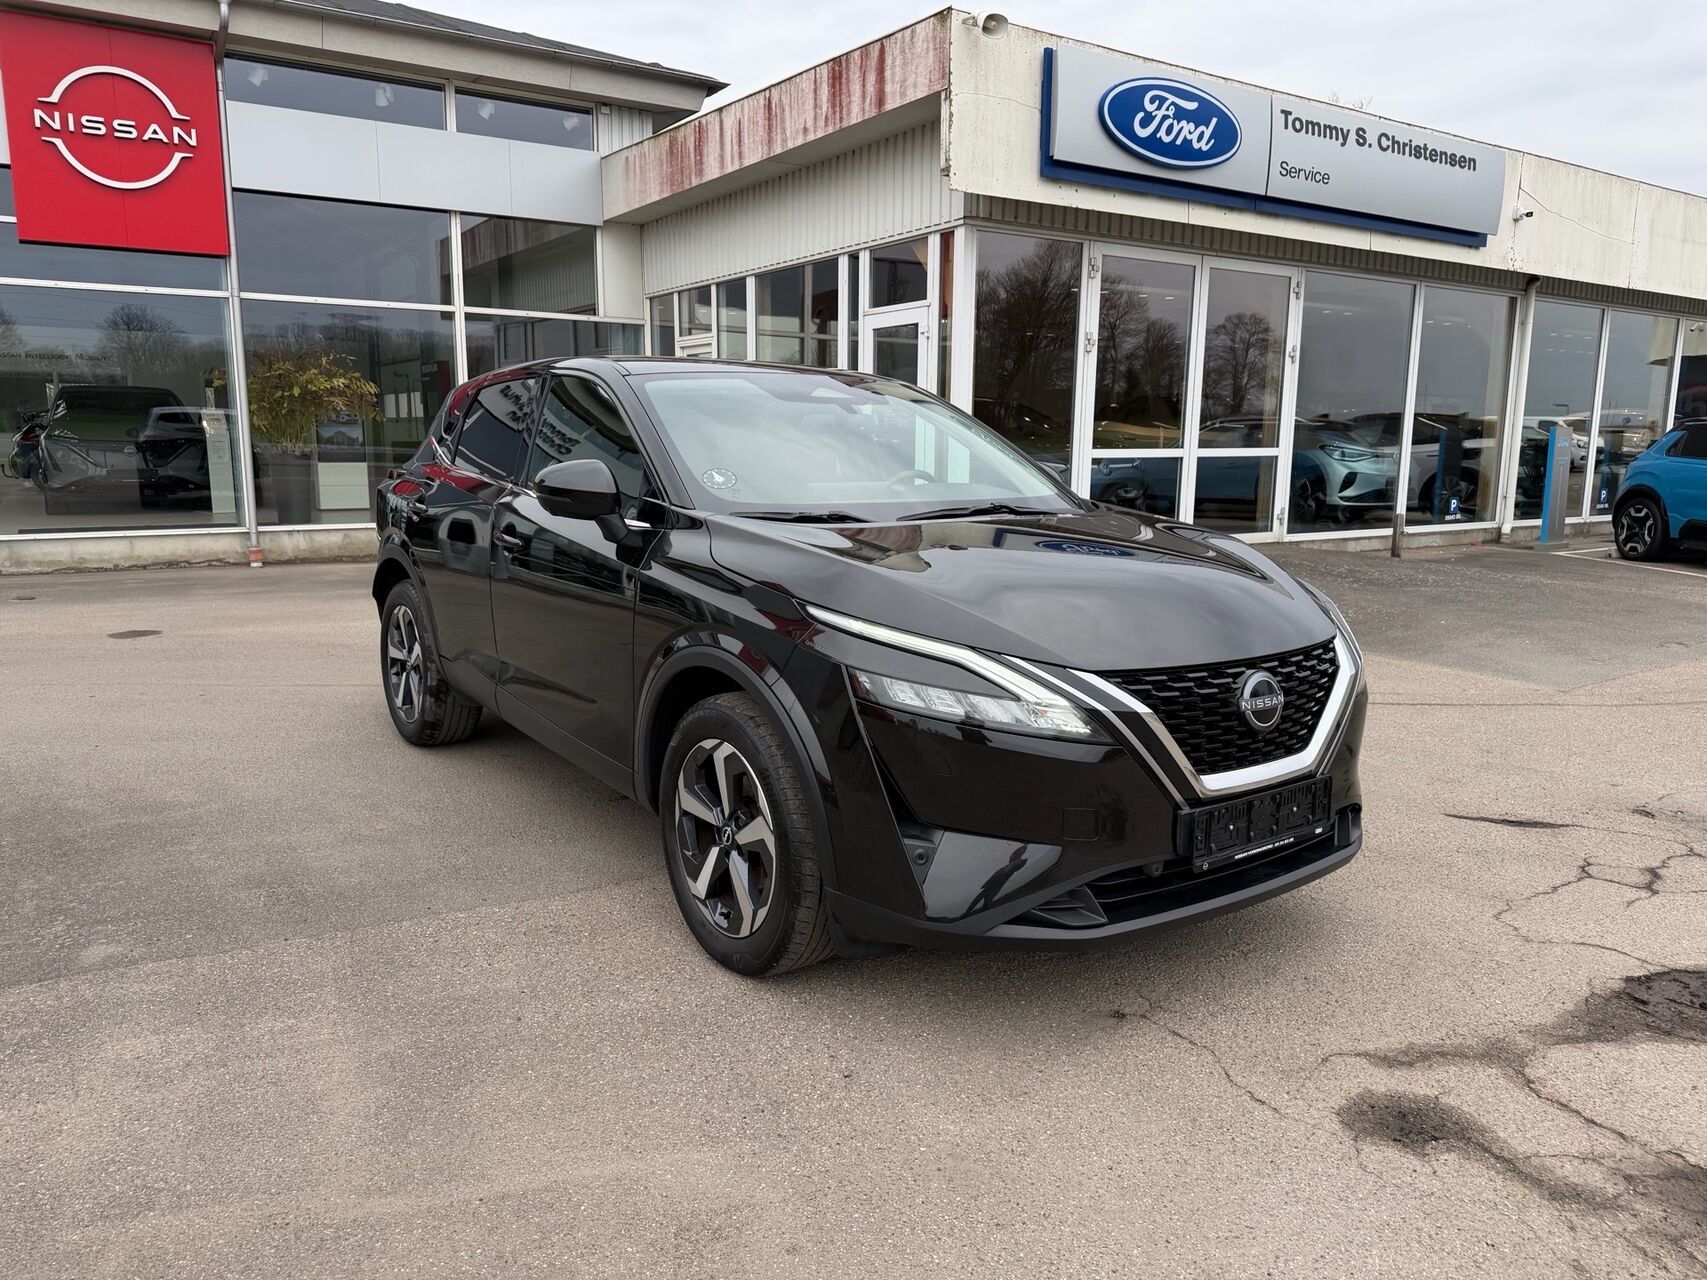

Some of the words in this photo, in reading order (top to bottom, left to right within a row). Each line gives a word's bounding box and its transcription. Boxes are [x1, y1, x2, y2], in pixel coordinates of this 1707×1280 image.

[33, 108, 198, 147] NISSAN
[1133, 89, 1218, 152] Ford
[1280, 109, 1351, 147] Tommy
[1355, 127, 1373, 149] S.
[1377, 132, 1477, 172] Christensen
[1279, 160, 1331, 185] Service
[1450, 499, 1458, 512] P
[1601, 490, 1608, 501] P
[1241, 694, 1285, 710] NISSAN
